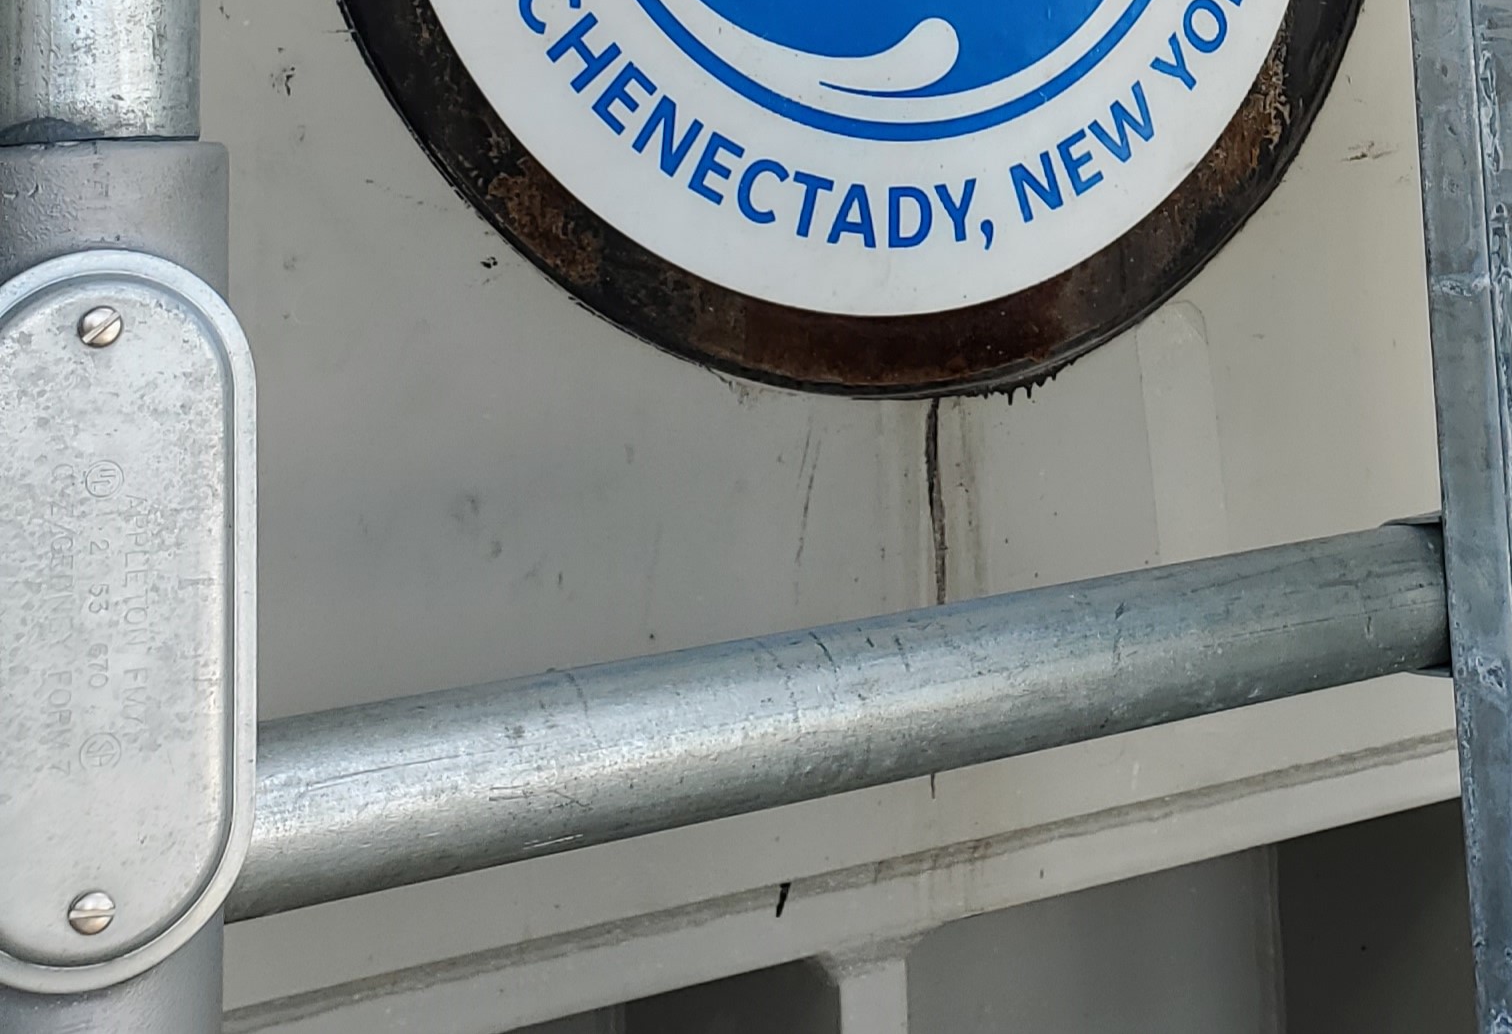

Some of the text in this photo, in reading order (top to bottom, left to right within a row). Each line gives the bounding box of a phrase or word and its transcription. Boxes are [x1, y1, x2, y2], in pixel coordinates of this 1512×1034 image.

[1008, 81, 1155, 223] NEW
[122, 494, 149, 646] APPLETON
[46, 670, 73, 750] FORM
